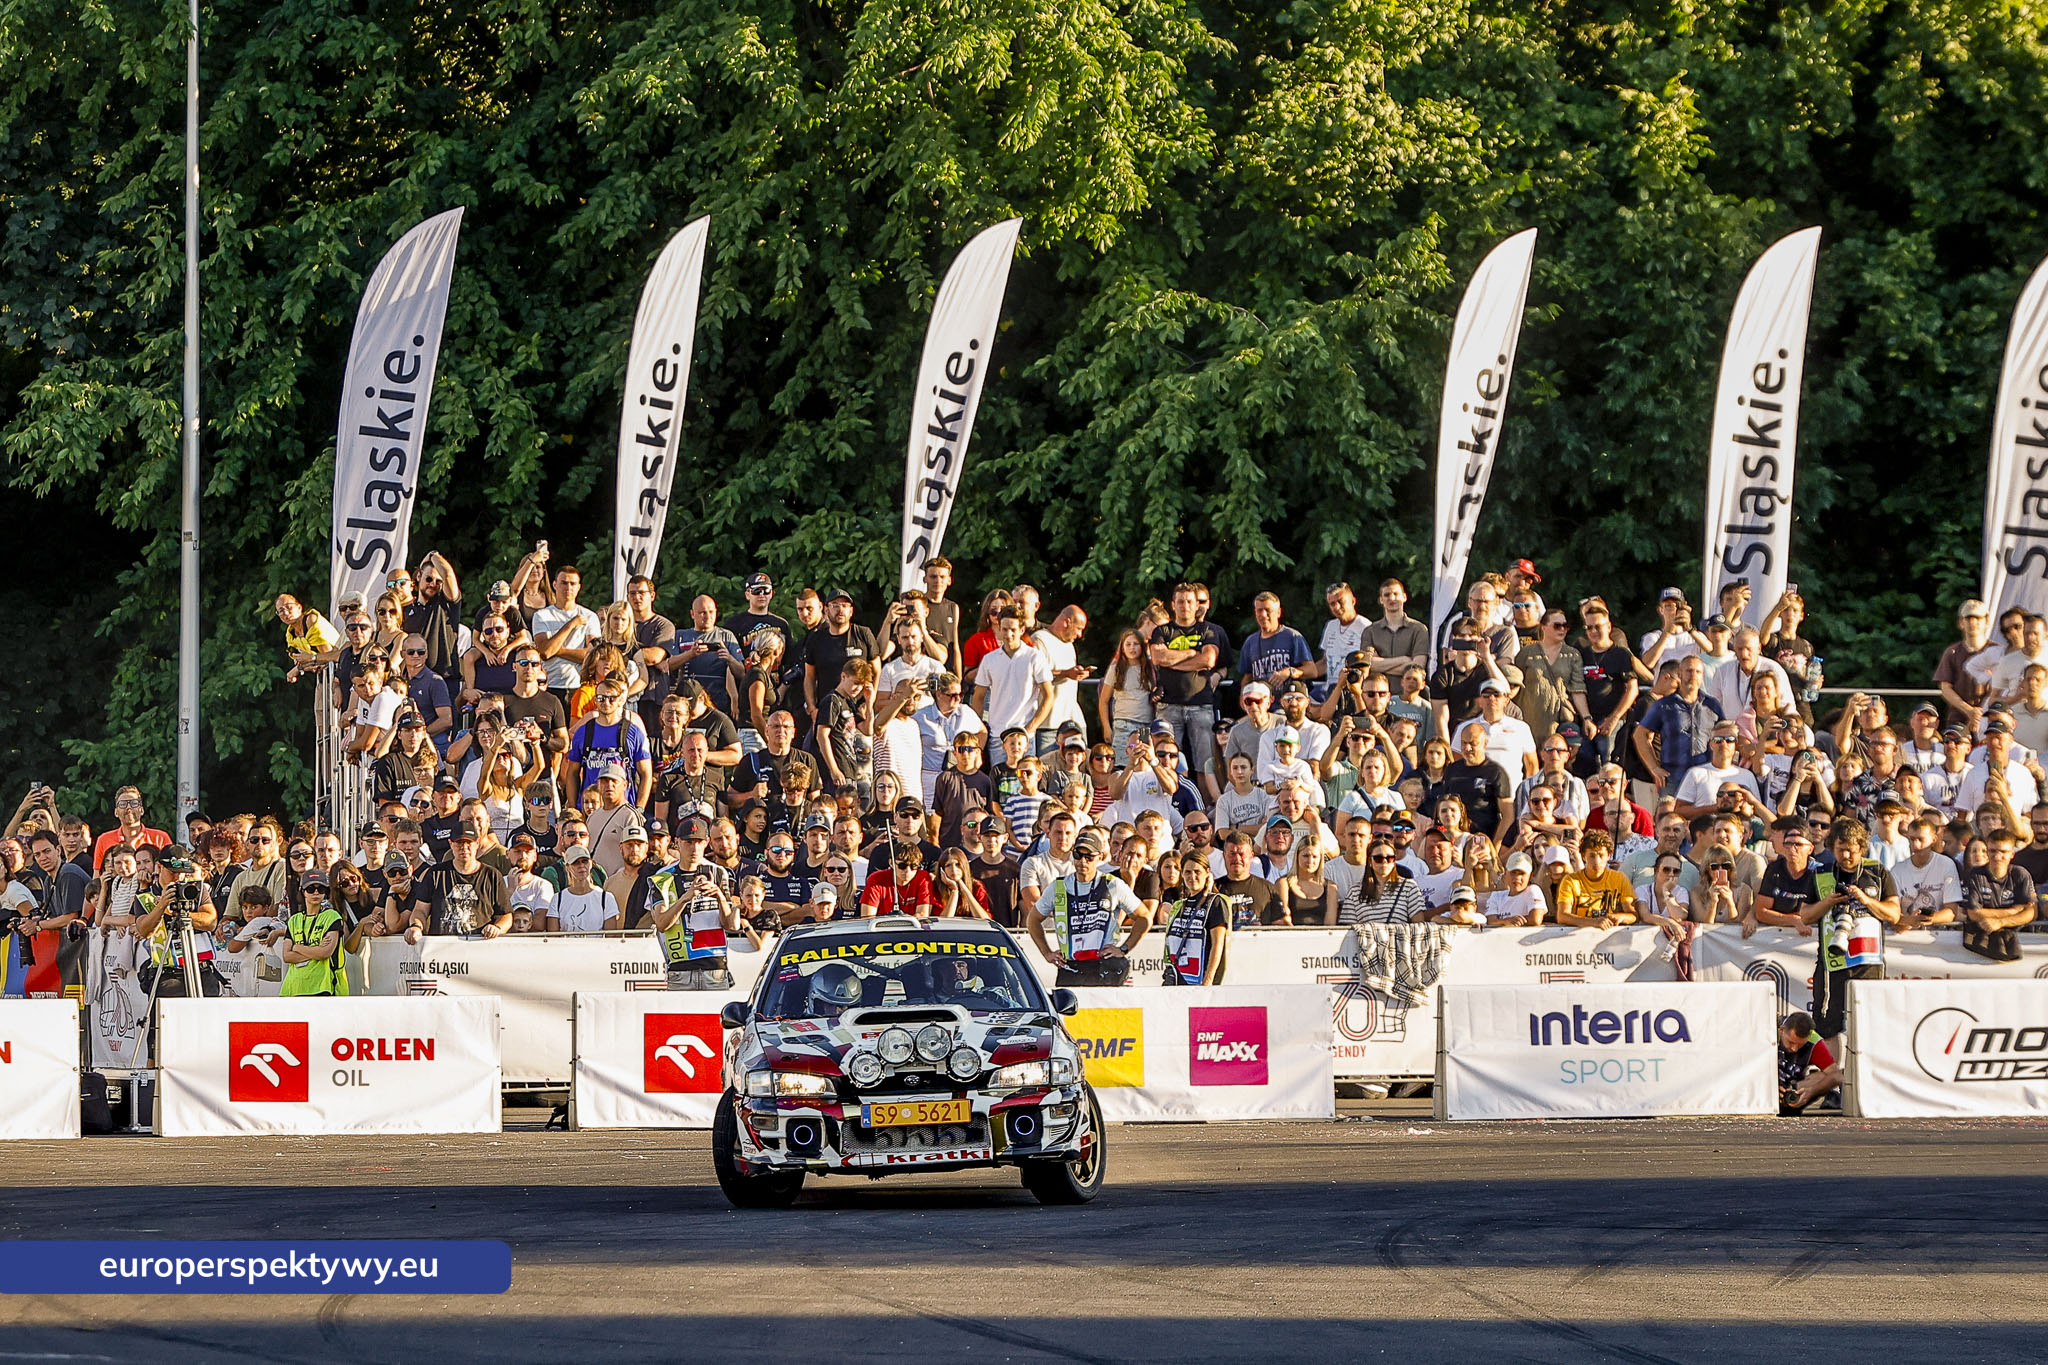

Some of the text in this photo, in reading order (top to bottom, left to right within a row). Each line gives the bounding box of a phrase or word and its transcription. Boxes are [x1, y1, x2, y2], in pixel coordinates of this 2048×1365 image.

[336, 334, 425, 575] Śląskie.
[1714, 348, 1790, 576] Śląskie.
[667, 931, 684, 960] POL
[780, 941, 1017, 966] RALLY CONTROL
[399, 958, 469, 979] STADION ŚLĄSKI
[610, 962, 659, 975] STADION
[1301, 956, 1349, 969] STADION
[1525, 951, 1615, 969] STADION ŚLĄSKI
[1530, 1004, 1691, 1046] interia
[1078, 1037, 1136, 1059] RMF
[1196, 1031, 1225, 1043] RMF
[331, 1037, 435, 1061] ORLEN
[1332, 1045, 1367, 1059] GENDY
[332, 1068, 370, 1088] OIL
[1560, 1057, 1666, 1084] SPORT
[874, 1102, 962, 1125] S9 5621
[886, 1148, 990, 1164] kratki
